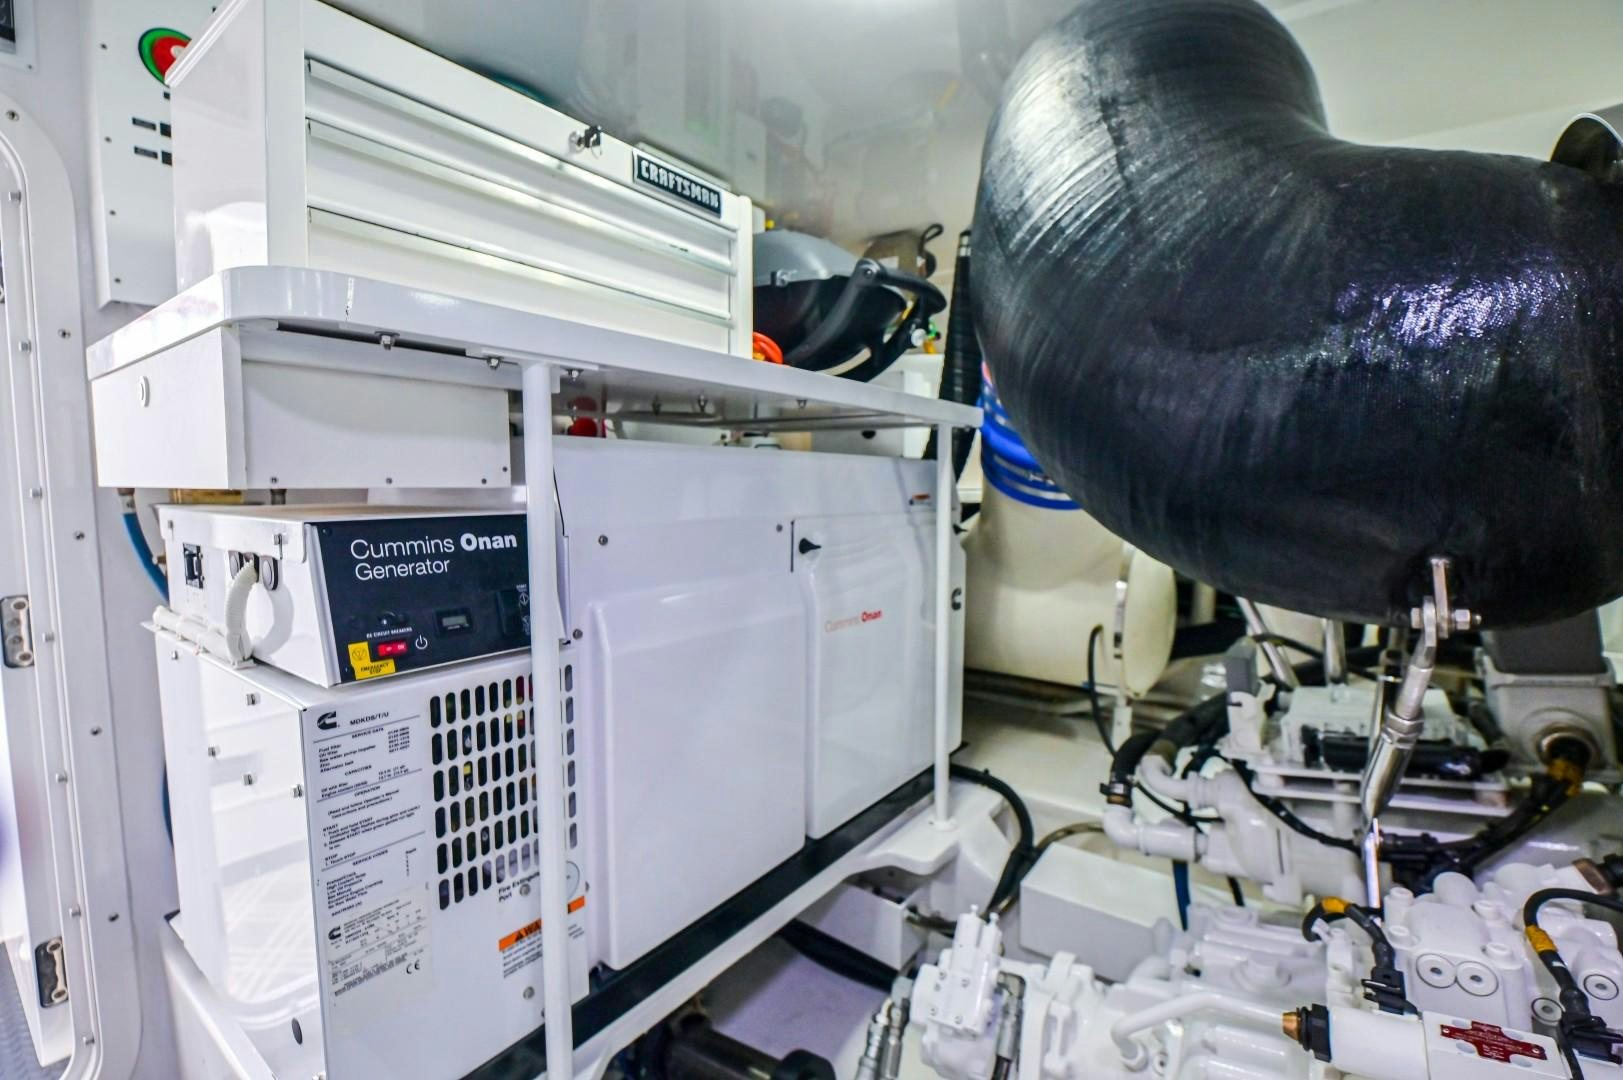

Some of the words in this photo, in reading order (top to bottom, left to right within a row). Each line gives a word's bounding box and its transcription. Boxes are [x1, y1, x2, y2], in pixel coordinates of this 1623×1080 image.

[639, 157, 720, 210] CRAFTSMAN
[350, 535, 455, 559] Cummins
[460, 533, 517, 552] Onan
[355, 559, 450, 581] Generator
[861, 610, 882, 622] Onan
[391, 627, 413, 635] BREAKERS
[361, 663, 389, 672] EMERGENCY
